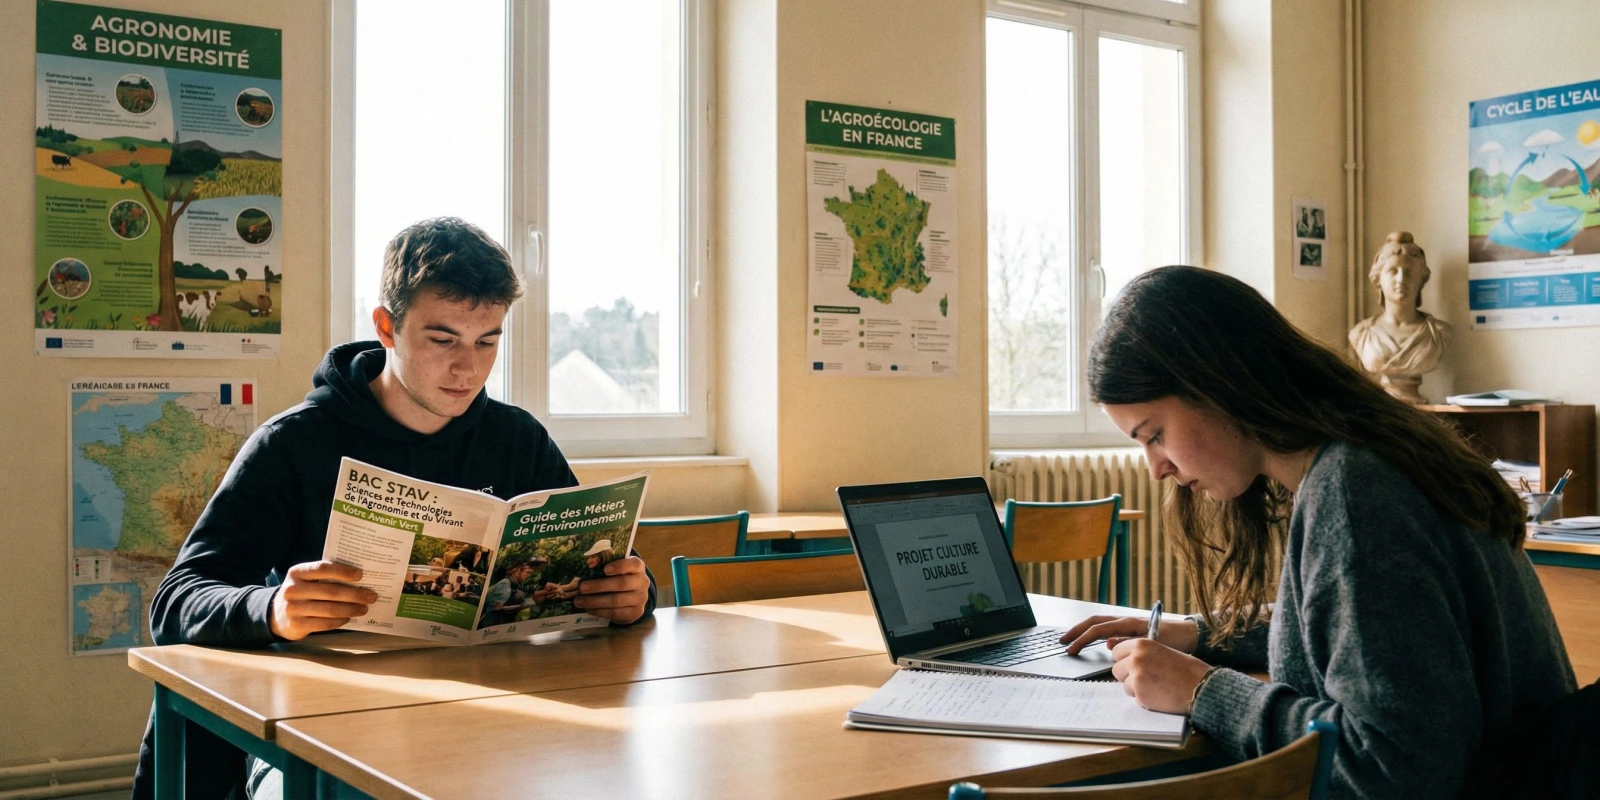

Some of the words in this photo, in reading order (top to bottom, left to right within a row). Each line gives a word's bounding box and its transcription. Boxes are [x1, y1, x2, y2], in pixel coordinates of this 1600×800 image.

[91, 15, 232, 47] AGRONOMIE
[71, 34, 88, 51] &
[95, 36, 250, 69] BIODIVERSITÉ
[1486, 99, 1532, 118] CYCLE
[1536, 95, 1557, 110] DE
[1560, 88, 1600, 107] L'EAU
[821, 109, 942, 136] L'AGROÉCOLOGIE
[842, 129, 862, 143] EN
[866, 132, 923, 150] FRANCE
[138, 382, 170, 390] FRANCE
[348, 469, 383, 489] BAC
[386, 482, 430, 502] STAV
[344, 492, 355, 502] de
[357, 494, 409, 517] l'Agronomie
[410, 511, 420, 520] et
[421, 512, 434, 522] du
[435, 514, 464, 528] Vivant
[346, 483, 383, 501] Sciences
[384, 495, 394, 504] et
[396, 497, 453, 517] Technologies
[520, 509, 557, 525] Guide
[560, 507, 581, 519] des
[584, 499, 625, 515] Métiers
[342, 503, 367, 518] Votre
[368, 511, 398, 526] Avenir
[399, 520, 419, 532] Vert
[513, 526, 529, 537] de
[532, 509, 627, 535] l'Environnement
[896, 548, 934, 566] PROJET
[936, 542, 979, 559] CULTURE
[922, 561, 969, 581] DURABLE
